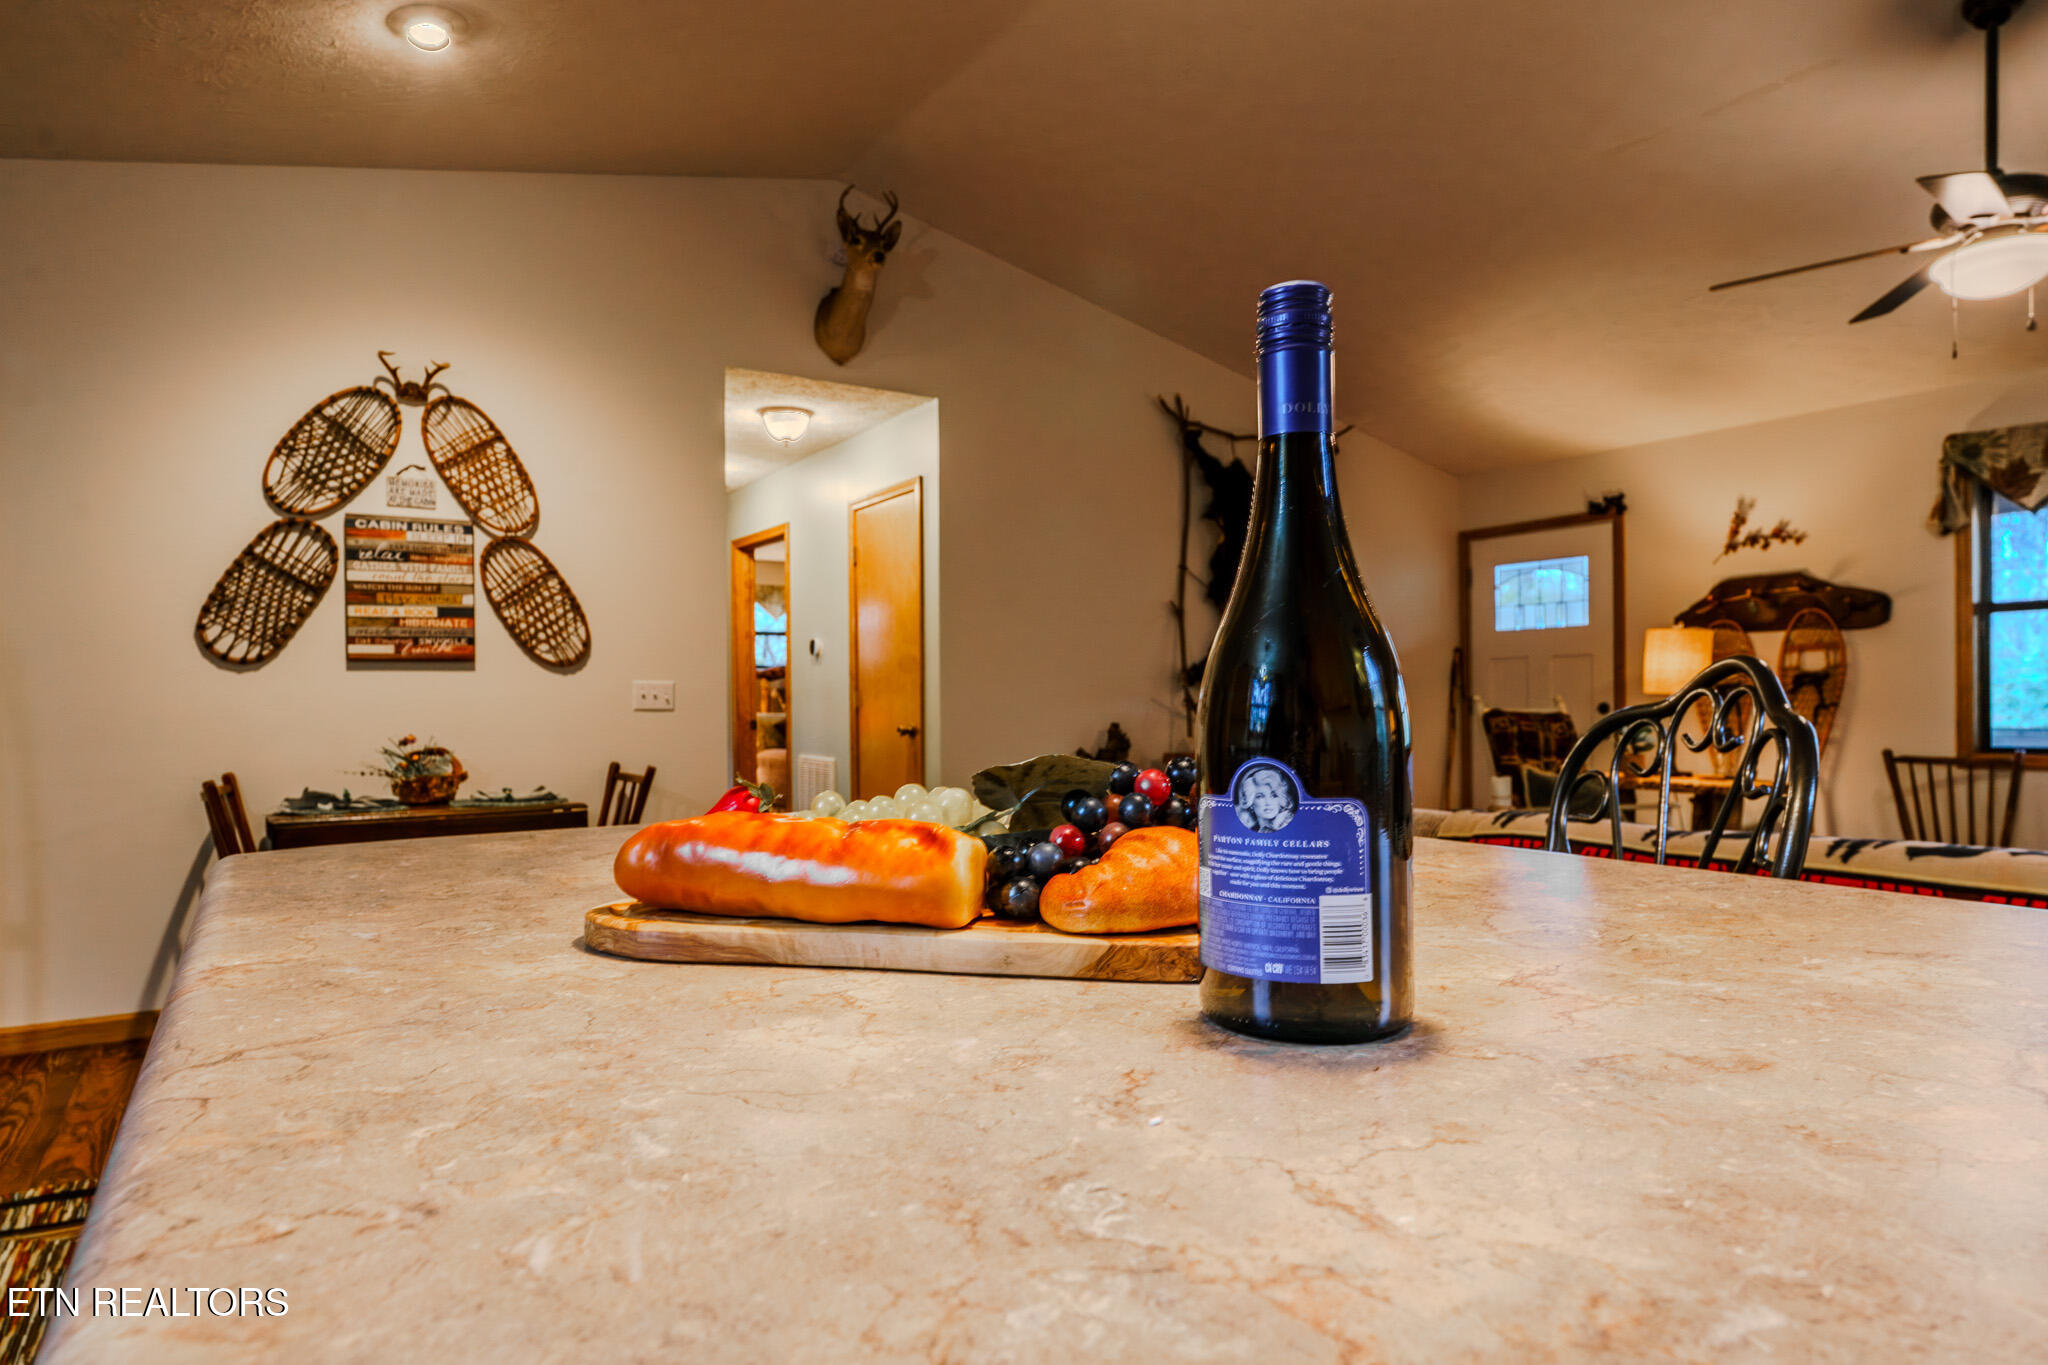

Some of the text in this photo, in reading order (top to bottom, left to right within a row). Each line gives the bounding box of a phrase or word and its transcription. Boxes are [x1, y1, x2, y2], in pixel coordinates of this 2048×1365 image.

[354, 518, 464, 534] CABIN RULES
[402, 562, 428, 573] WITH
[430, 564, 468, 574] FAMILY
[352, 583, 385, 591] WATCH
[387, 584, 404, 592] THE
[354, 606, 434, 617] READ A BOOK
[399, 618, 468, 628] HIBERNATE
[1213, 834, 1331, 848] PARTON FAMILY CELLARS
[1218, 890, 1316, 904] CHARDONNAY CALIFORNIA
